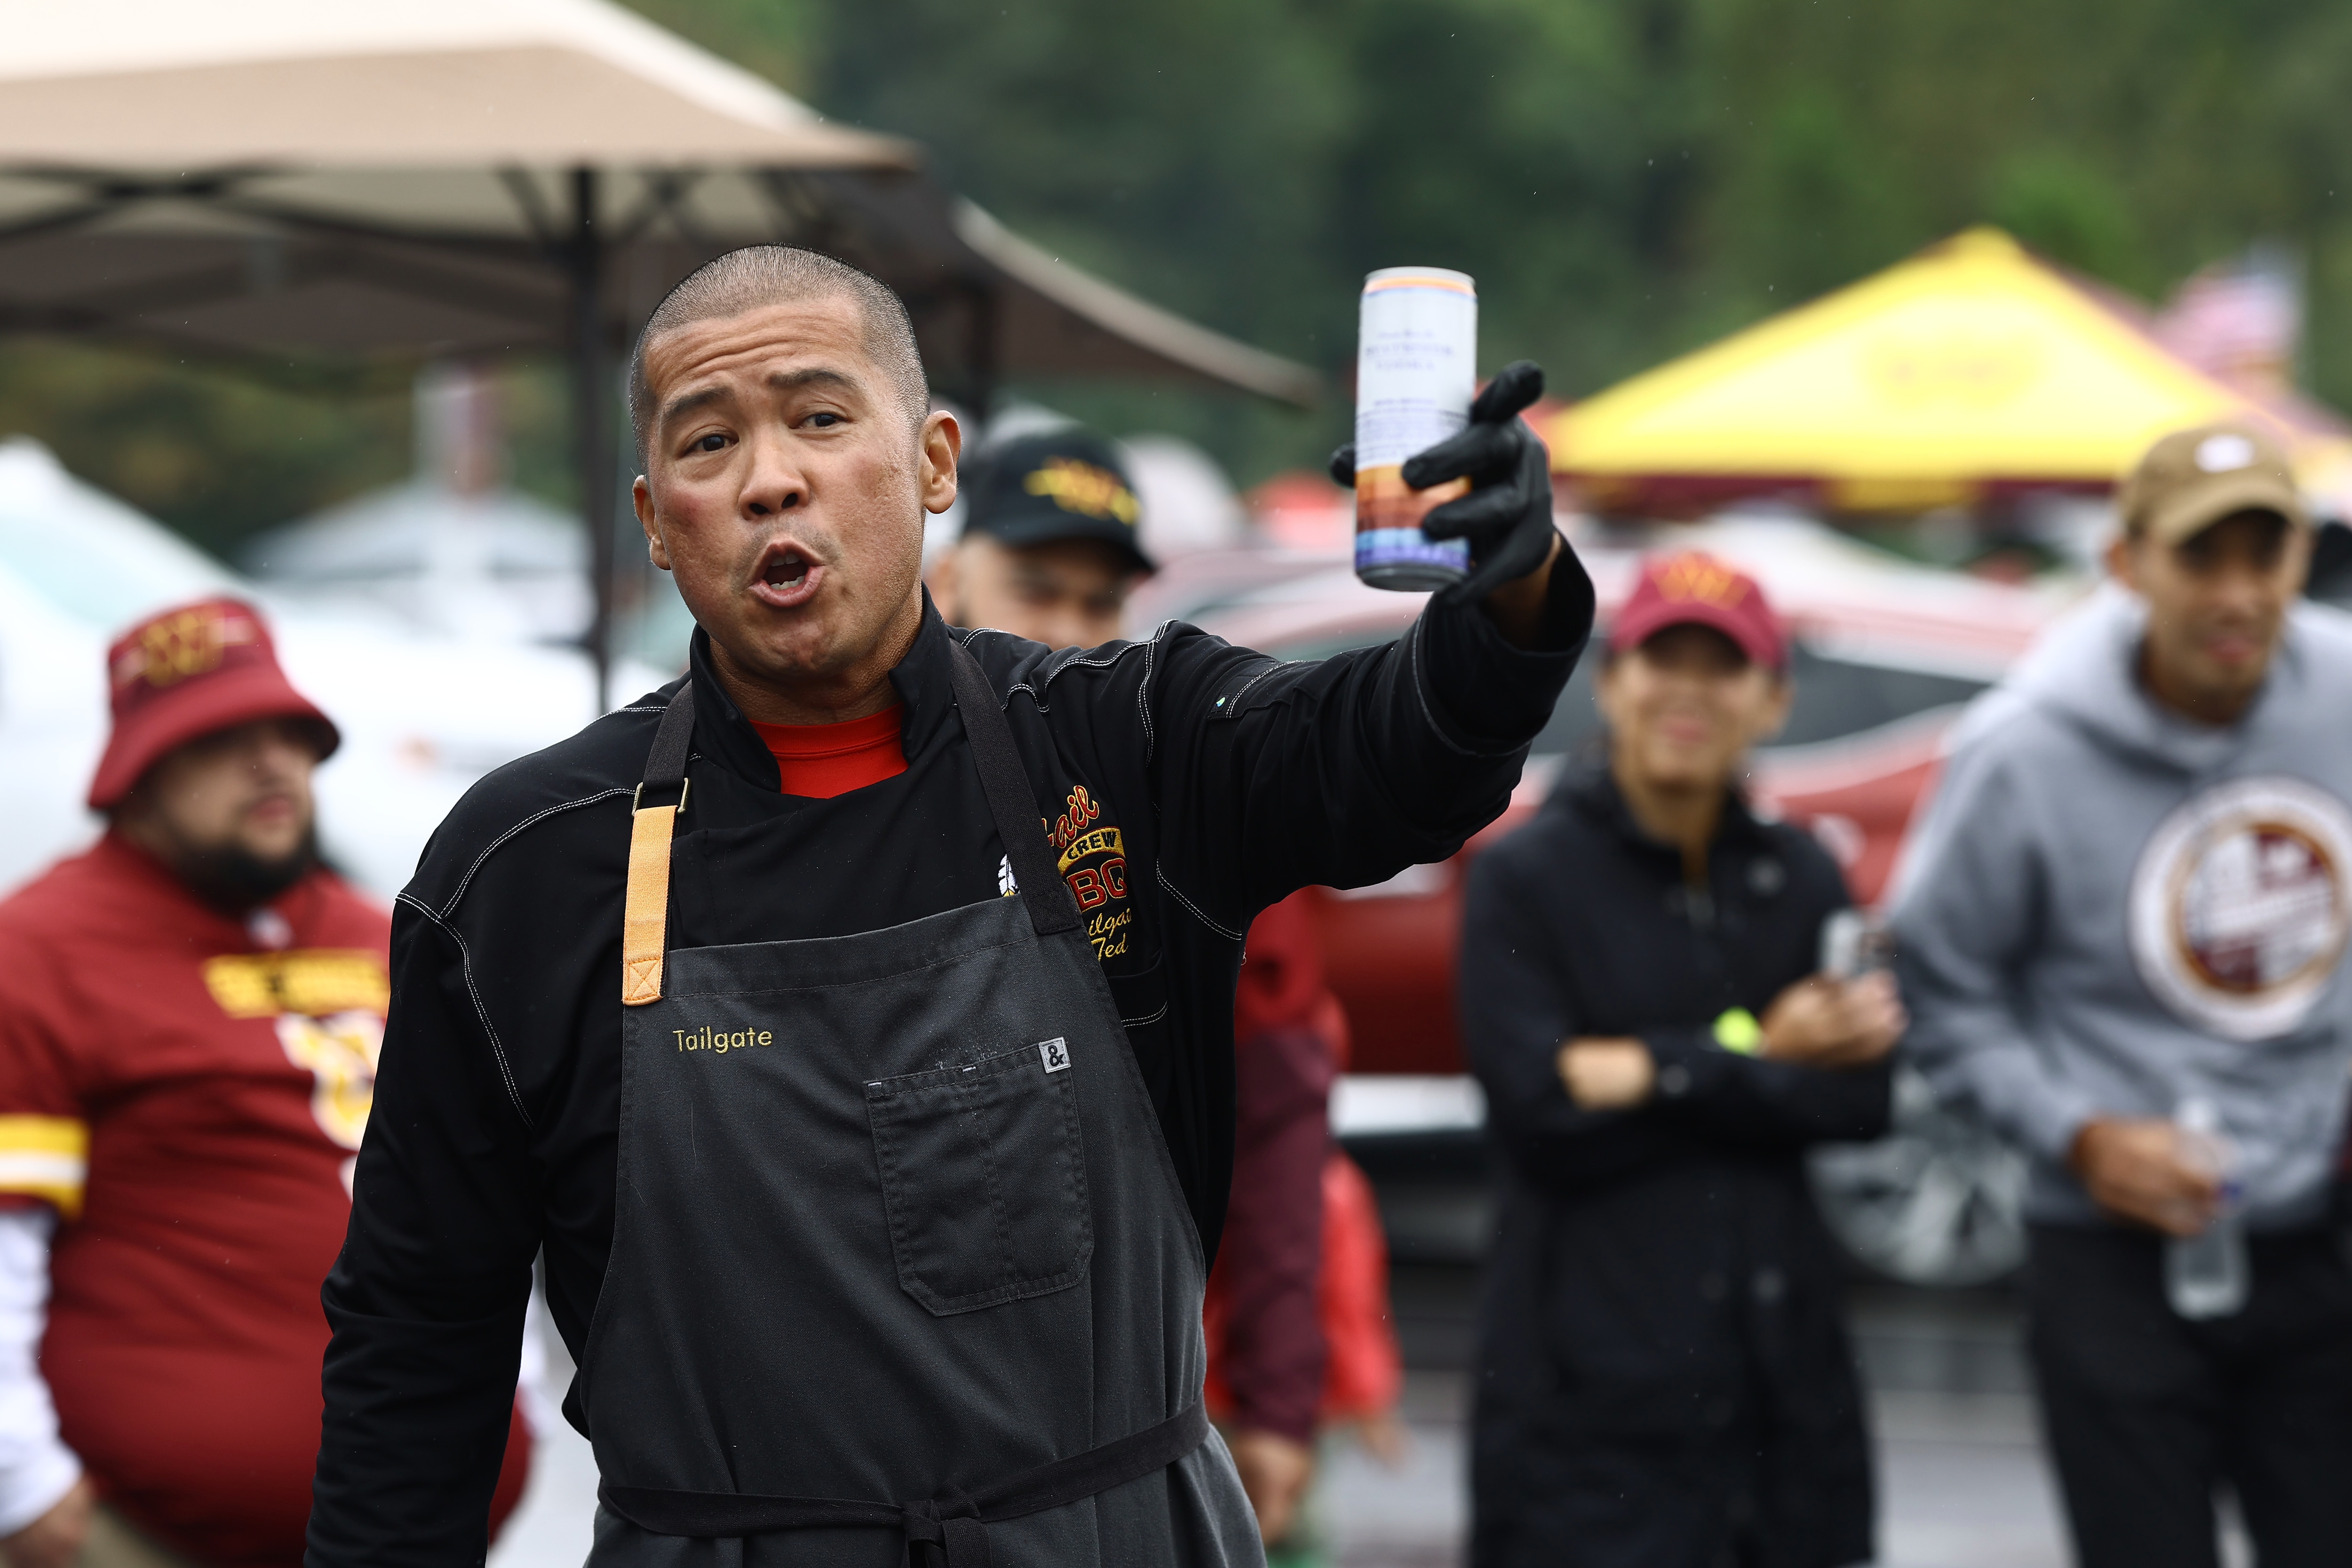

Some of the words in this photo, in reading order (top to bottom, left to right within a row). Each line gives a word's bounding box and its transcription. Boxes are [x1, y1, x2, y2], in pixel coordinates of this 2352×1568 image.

[1041, 785, 1099, 849] ail
[1067, 832, 1116, 860] CREW
[1064, 858, 1128, 913] BQ
[1091, 933, 1128, 961] Ted
[672, 1026, 772, 1054] Tailgate
[1048, 1045, 1065, 1067] &
